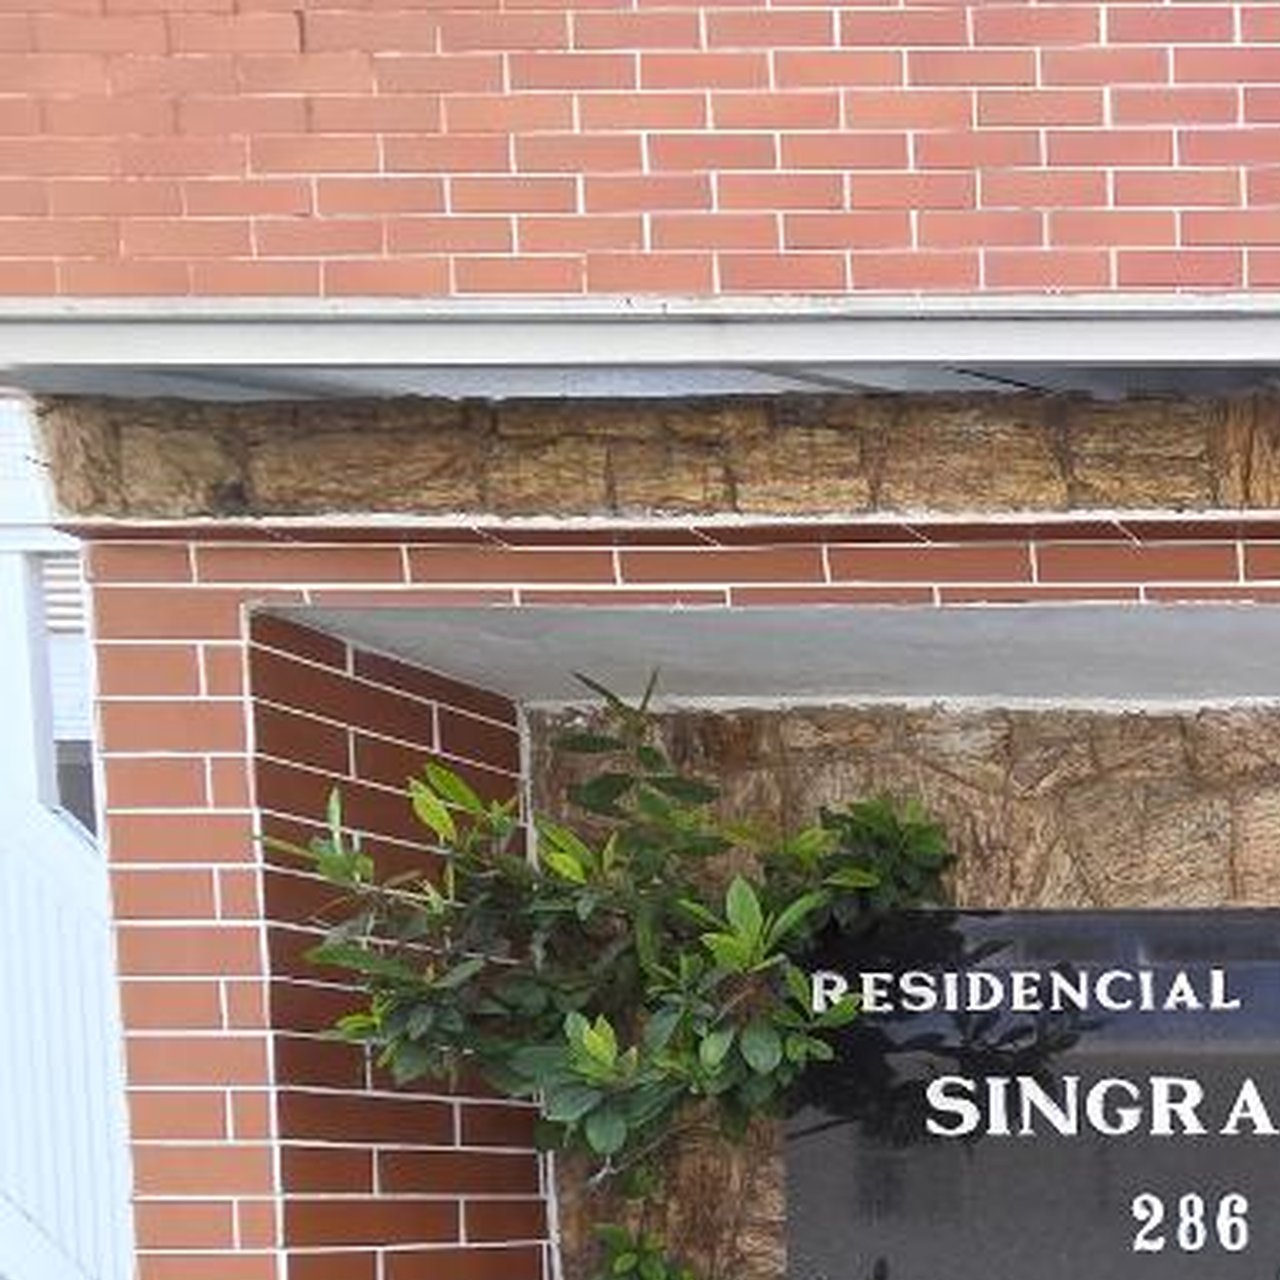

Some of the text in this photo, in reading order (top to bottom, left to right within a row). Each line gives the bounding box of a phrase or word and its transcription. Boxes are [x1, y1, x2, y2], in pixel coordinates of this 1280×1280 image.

[811, 969, 1241, 1012] RESIDENCIAL
[925, 1076, 1280, 1136] SINGRA
[1132, 1193, 1249, 1251] 286
